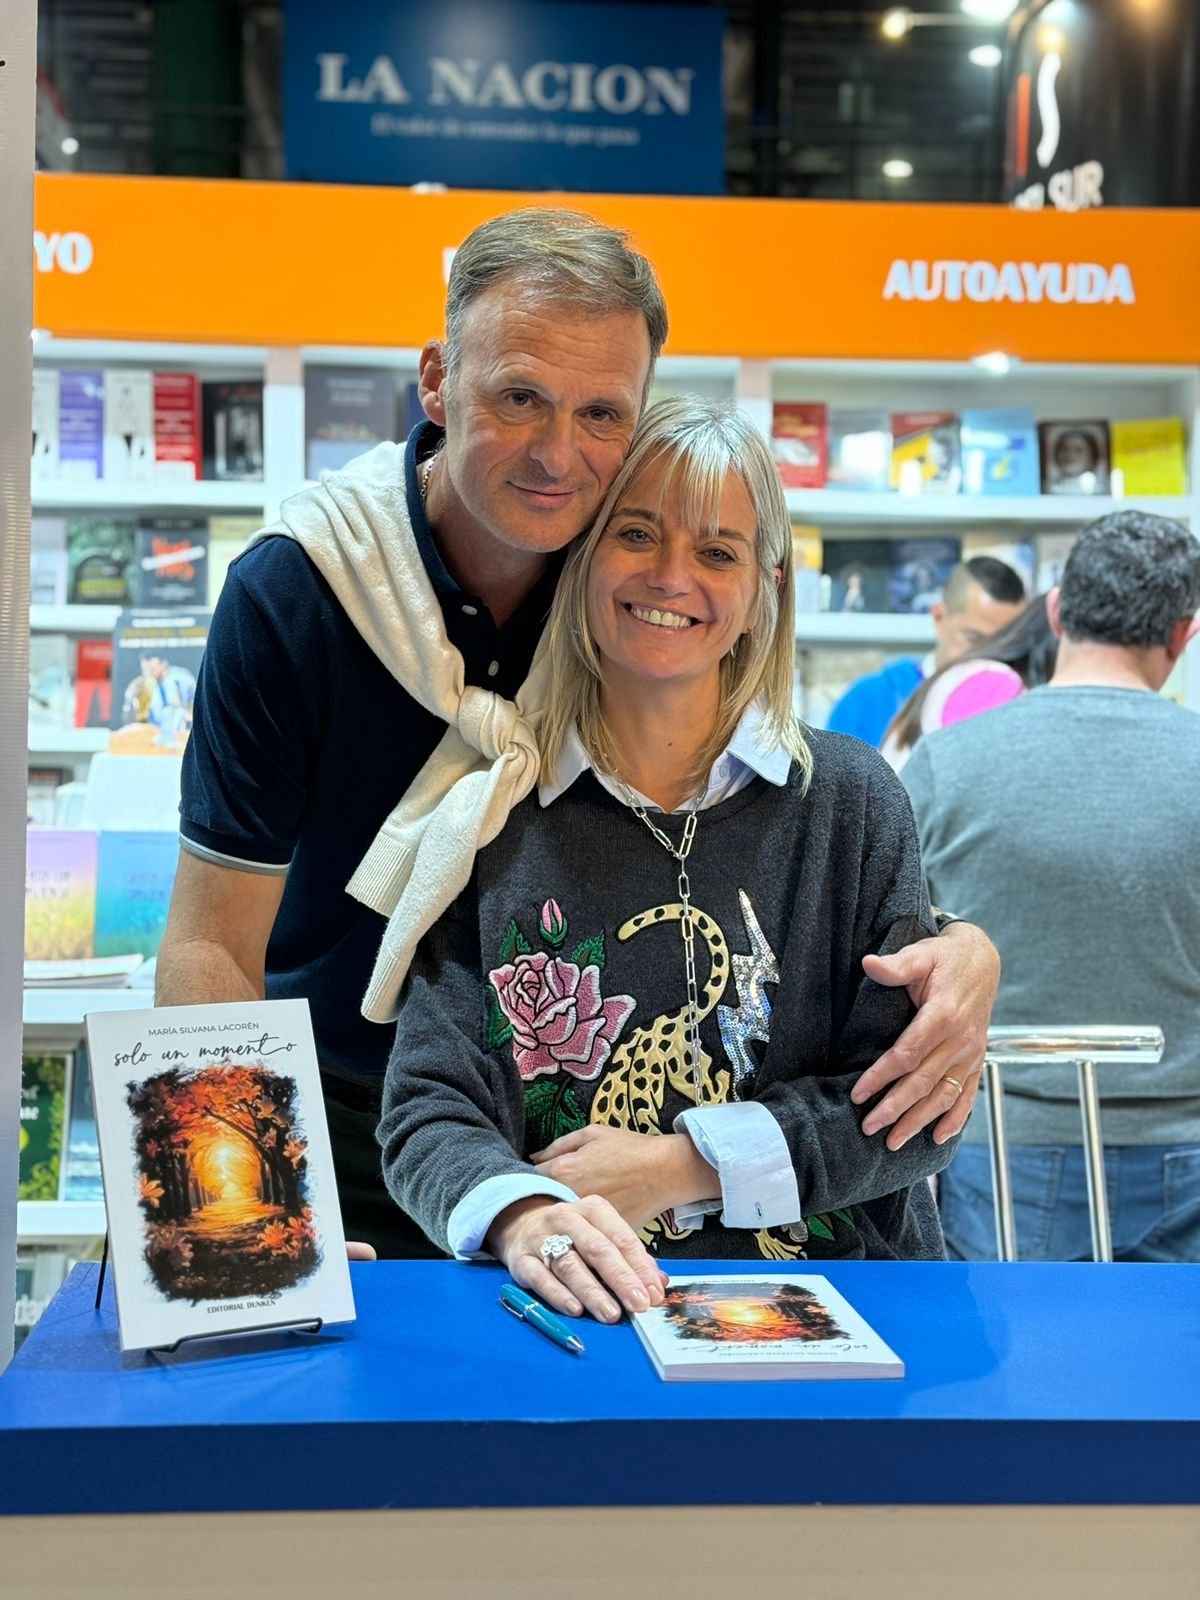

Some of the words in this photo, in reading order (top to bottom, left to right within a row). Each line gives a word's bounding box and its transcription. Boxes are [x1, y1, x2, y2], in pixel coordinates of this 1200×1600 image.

[316, 52, 410, 104] LA
[429, 57, 697, 115] NACION
[883, 259, 1136, 305] AUTOAYUDA
[148, 1026, 178, 1037] MARÍA
[180, 1024, 217, 1034] SILVANA
[218, 1022, 260, 1033] LACORÉN
[114, 1041, 152, 1067] solo
[161, 1048, 189, 1061] un
[199, 1032, 297, 1058] momento
[207, 1303, 245, 1314] EDITORIAL
[246, 1299, 277, 1309] DUNKEN
